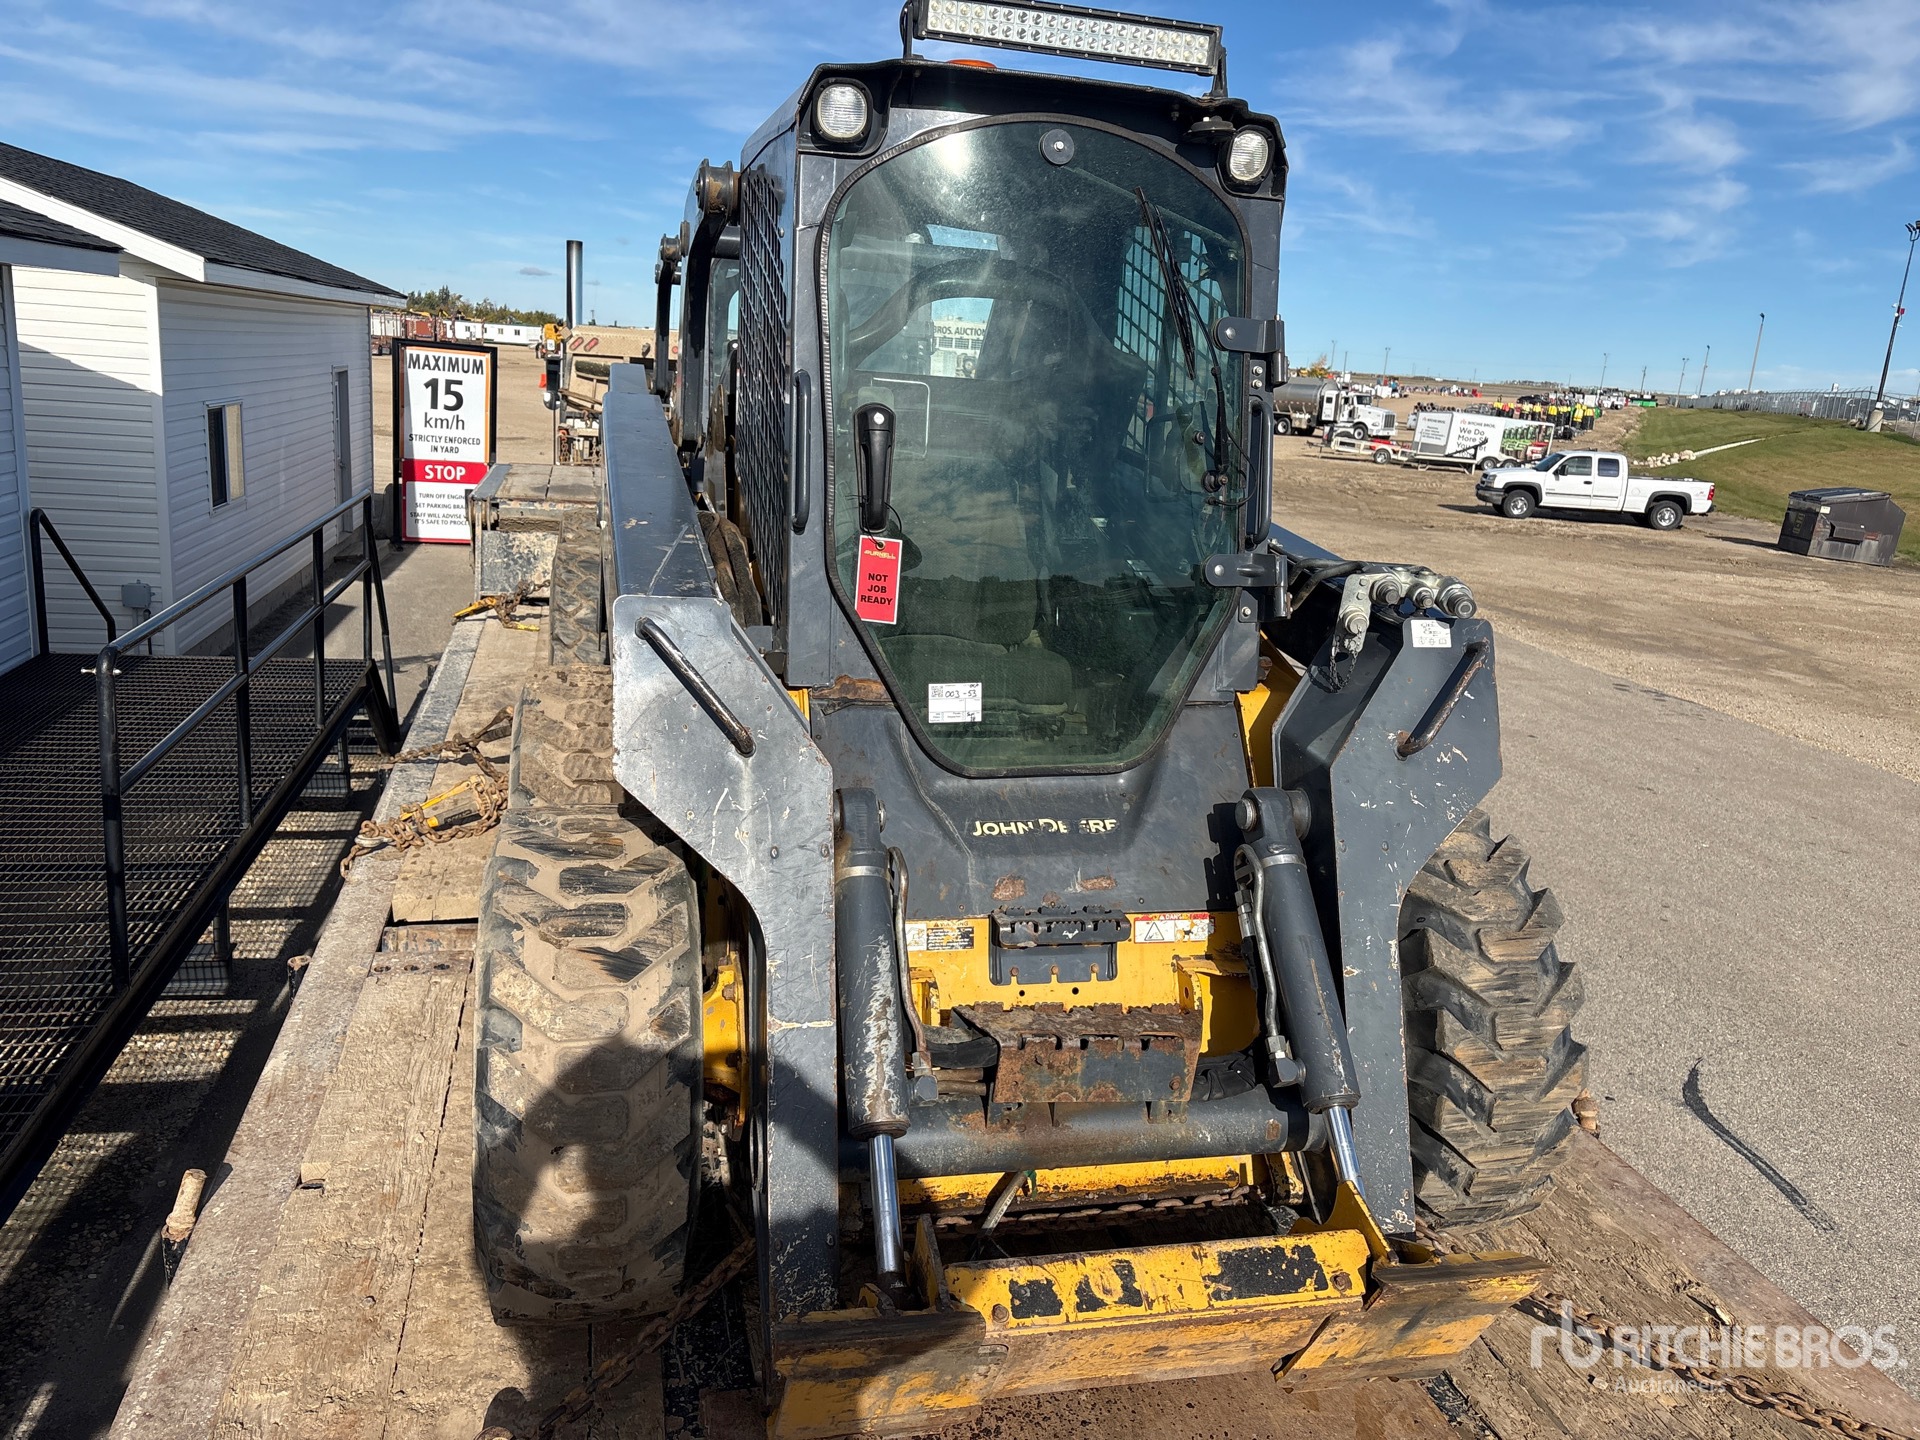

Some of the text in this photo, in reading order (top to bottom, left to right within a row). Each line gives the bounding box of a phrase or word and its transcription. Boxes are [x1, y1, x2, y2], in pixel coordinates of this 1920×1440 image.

[408, 353, 484, 375] MAXIMUM
[423, 378, 464, 411] 15
[424, 412, 465, 430] km/h
[409, 433, 481, 445] STRICTLY ENFORCED
[1458, 434, 1477, 442] More
[430, 445, 438, 453] IN
[424, 464, 466, 480] STOP
[868, 572, 888, 582] NOT
[867, 584, 887, 593] JOB
[860, 595, 893, 605] READY
[945, 690, 960, 699] 003
[972, 820, 1033, 837] JOHN
